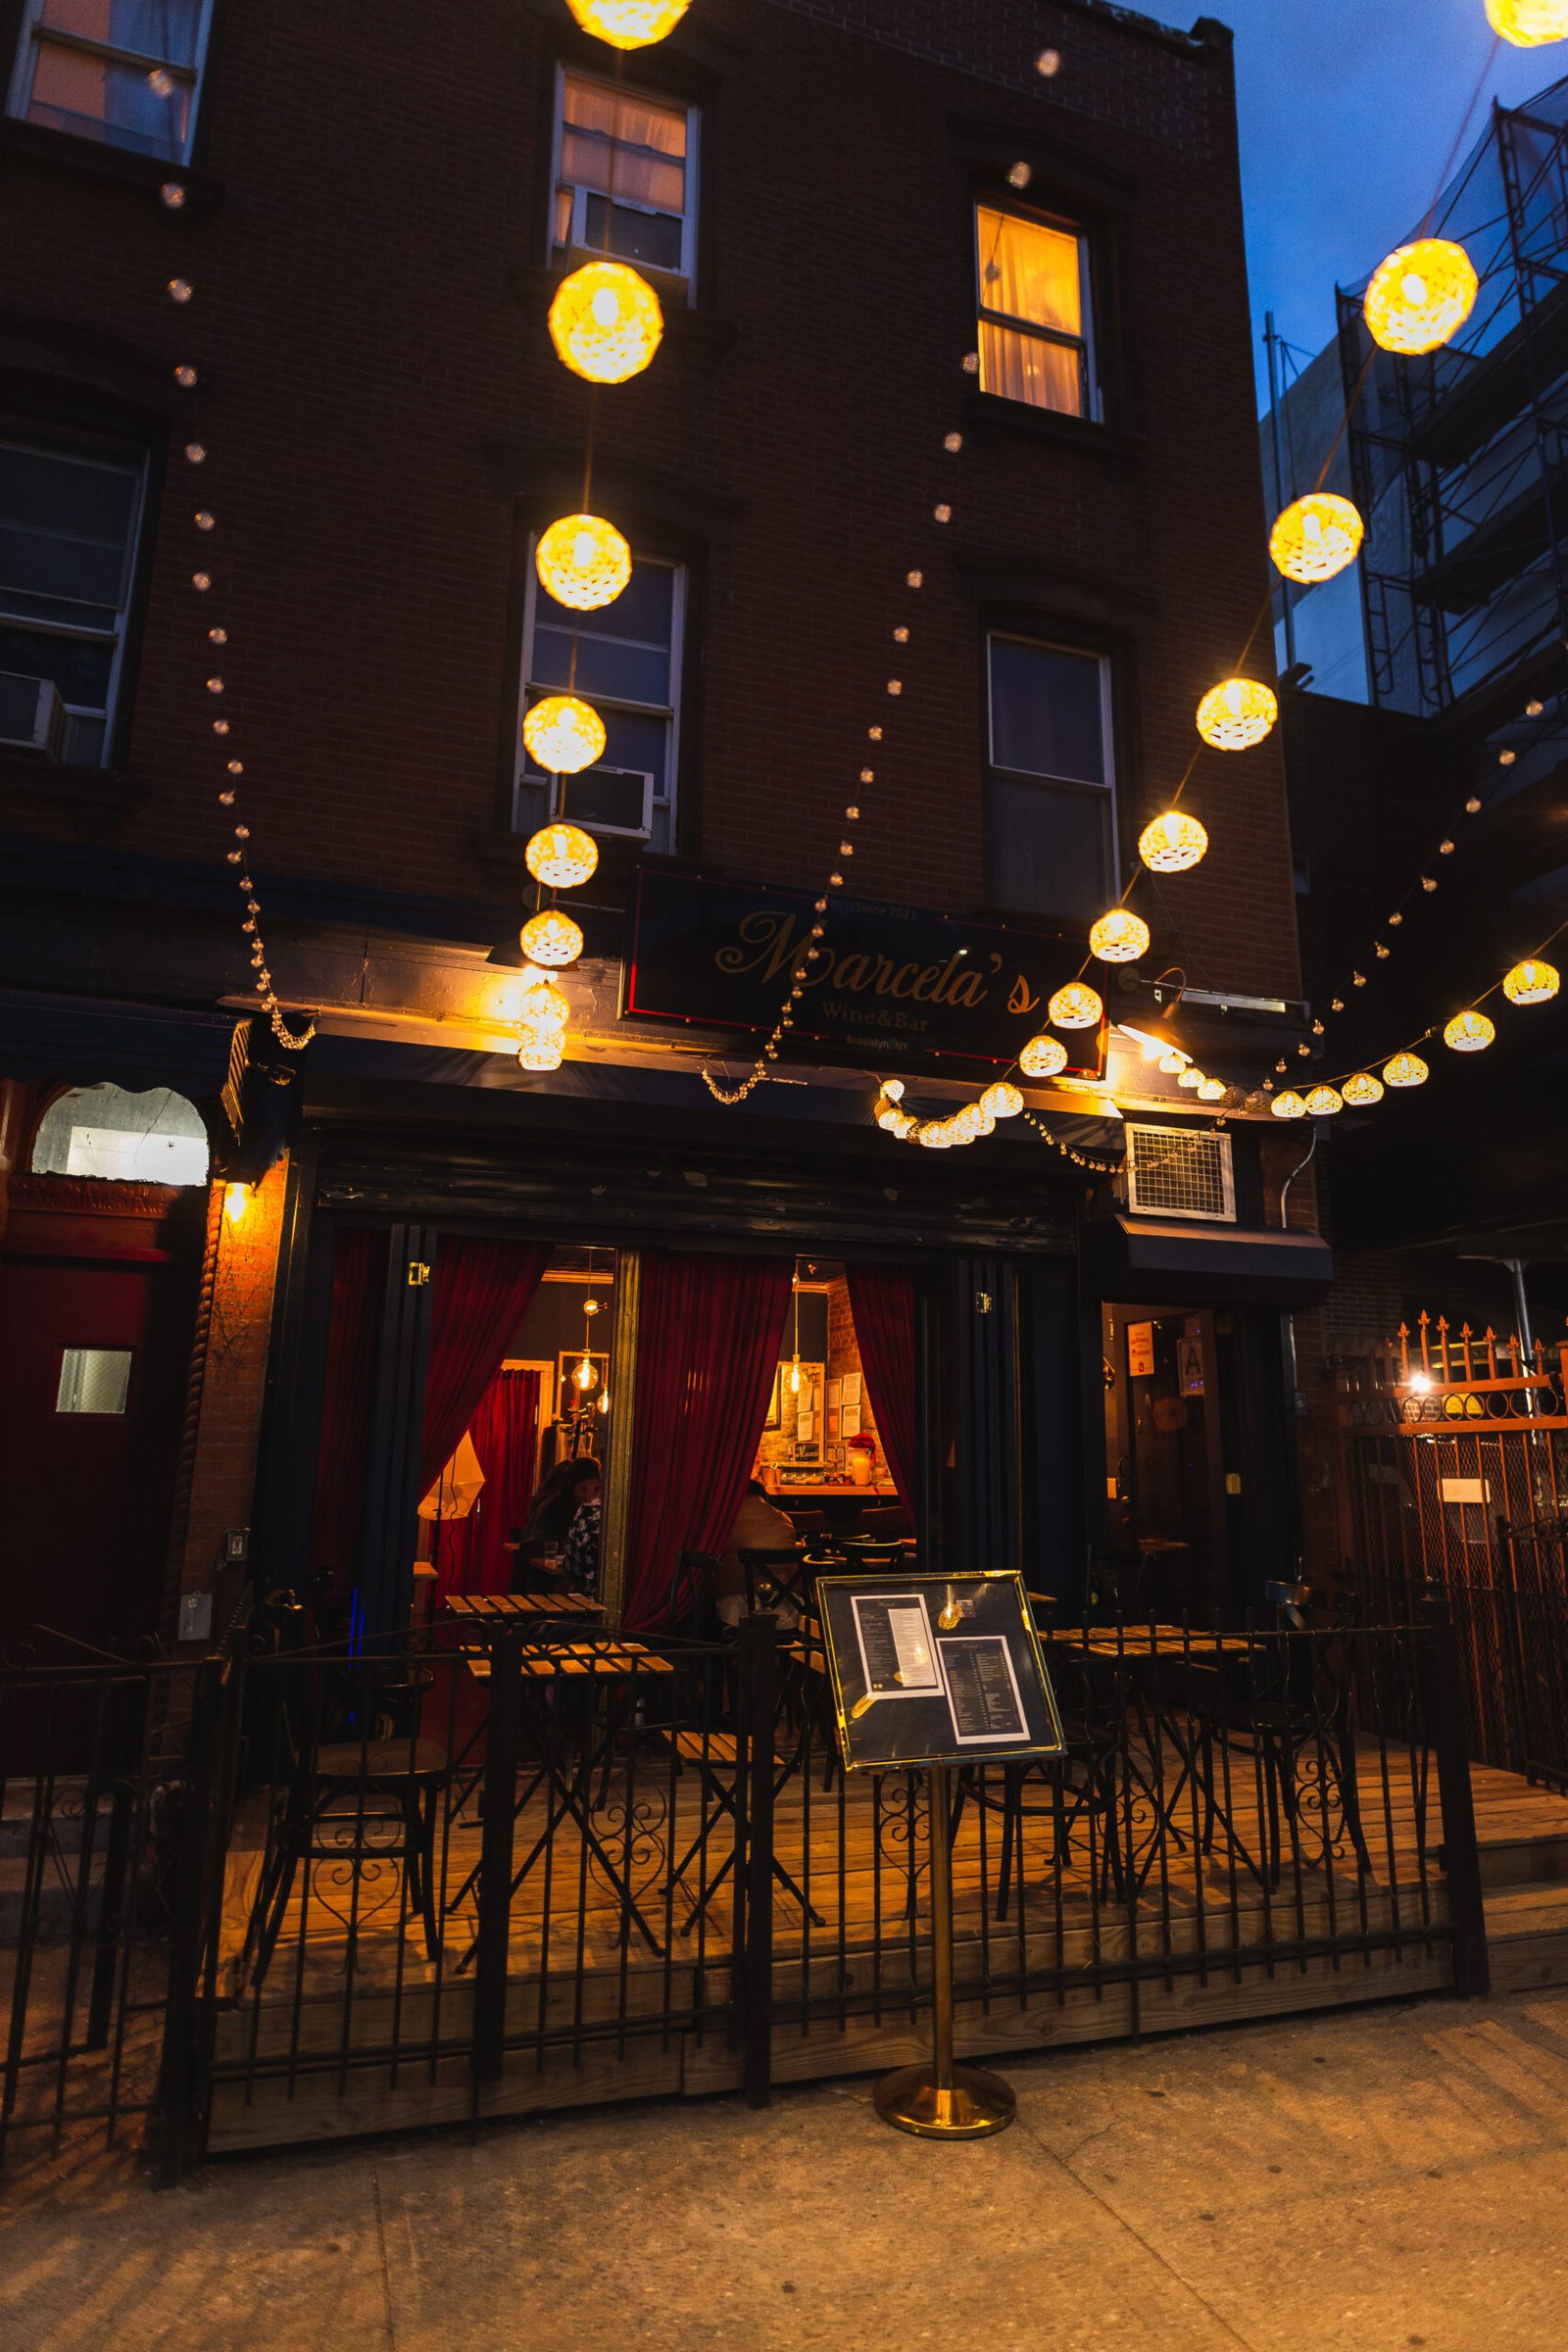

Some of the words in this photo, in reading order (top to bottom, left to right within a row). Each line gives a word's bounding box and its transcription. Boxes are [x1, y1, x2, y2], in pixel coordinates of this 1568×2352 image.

[855, 901, 887, 915] Since
[889, 906, 917, 921] 2021
[713, 909, 1041, 1014] Marcela's
[819, 1001, 932, 1032] Wine&Bar
[847, 1034, 893, 1051] Brooklyn,
[895, 1041, 909, 1051] NY
[1186, 1348, 1201, 1375] A
